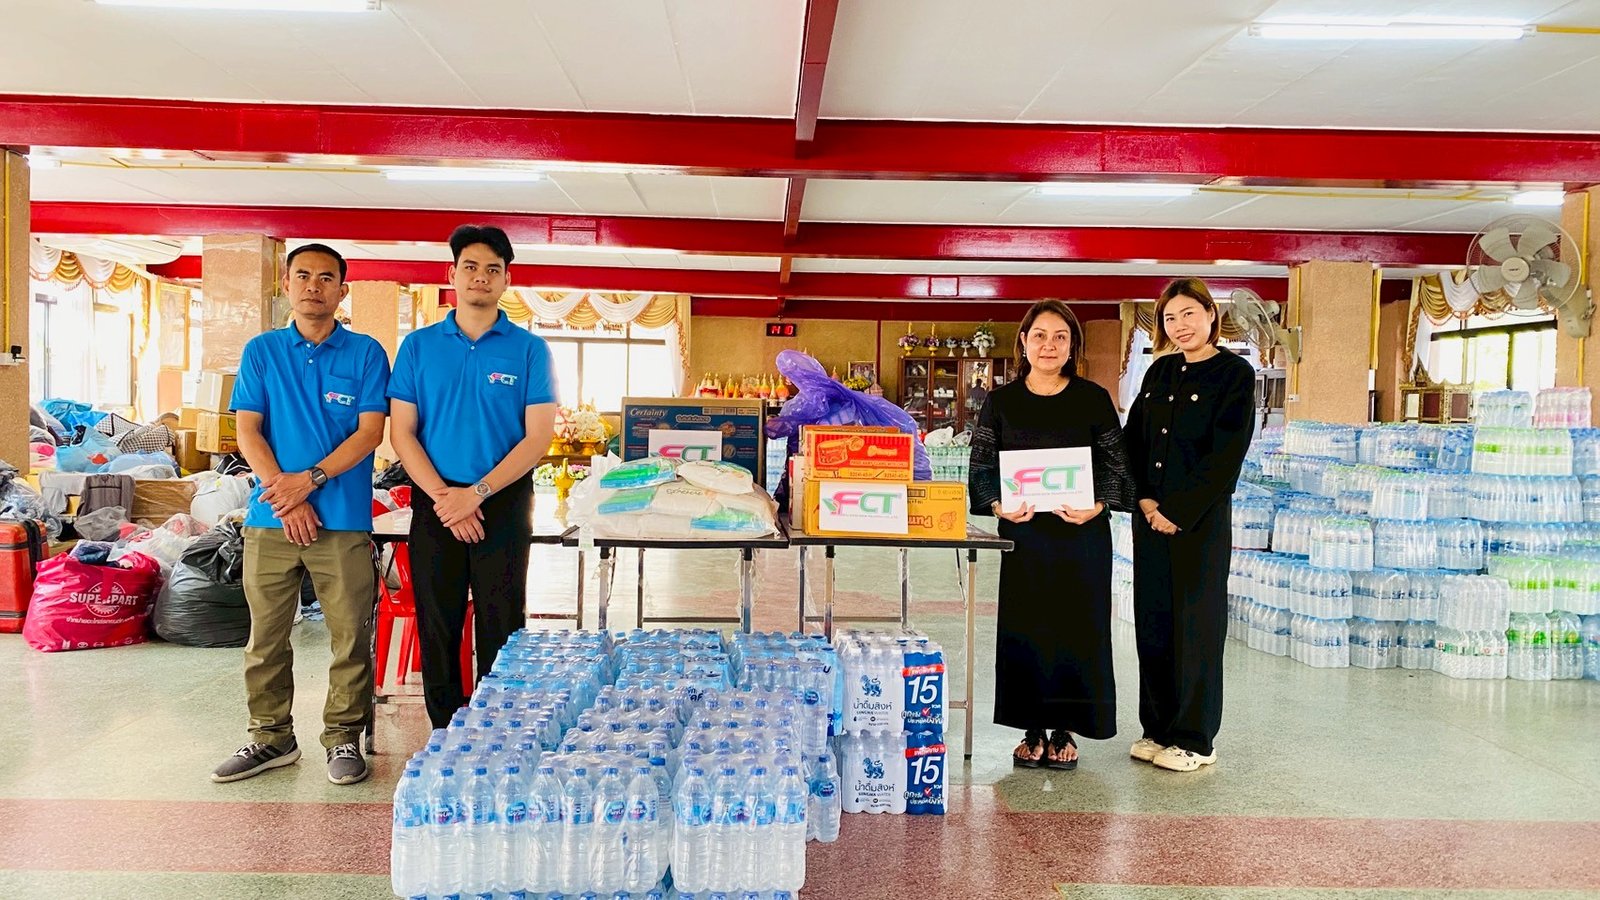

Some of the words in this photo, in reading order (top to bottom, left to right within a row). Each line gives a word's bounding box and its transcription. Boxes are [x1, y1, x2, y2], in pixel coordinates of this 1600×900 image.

[629, 408, 668, 418] Certainty
[1012, 464, 1082, 497] FCT
[831, 491, 902, 515] FCT
[908, 675, 940, 704] 15
[853, 697, 893, 710] น้ำดื่มสิงห์
[911, 756, 941, 785] 15
[854, 780, 895, 792] น้ำดื่มสิงห์
